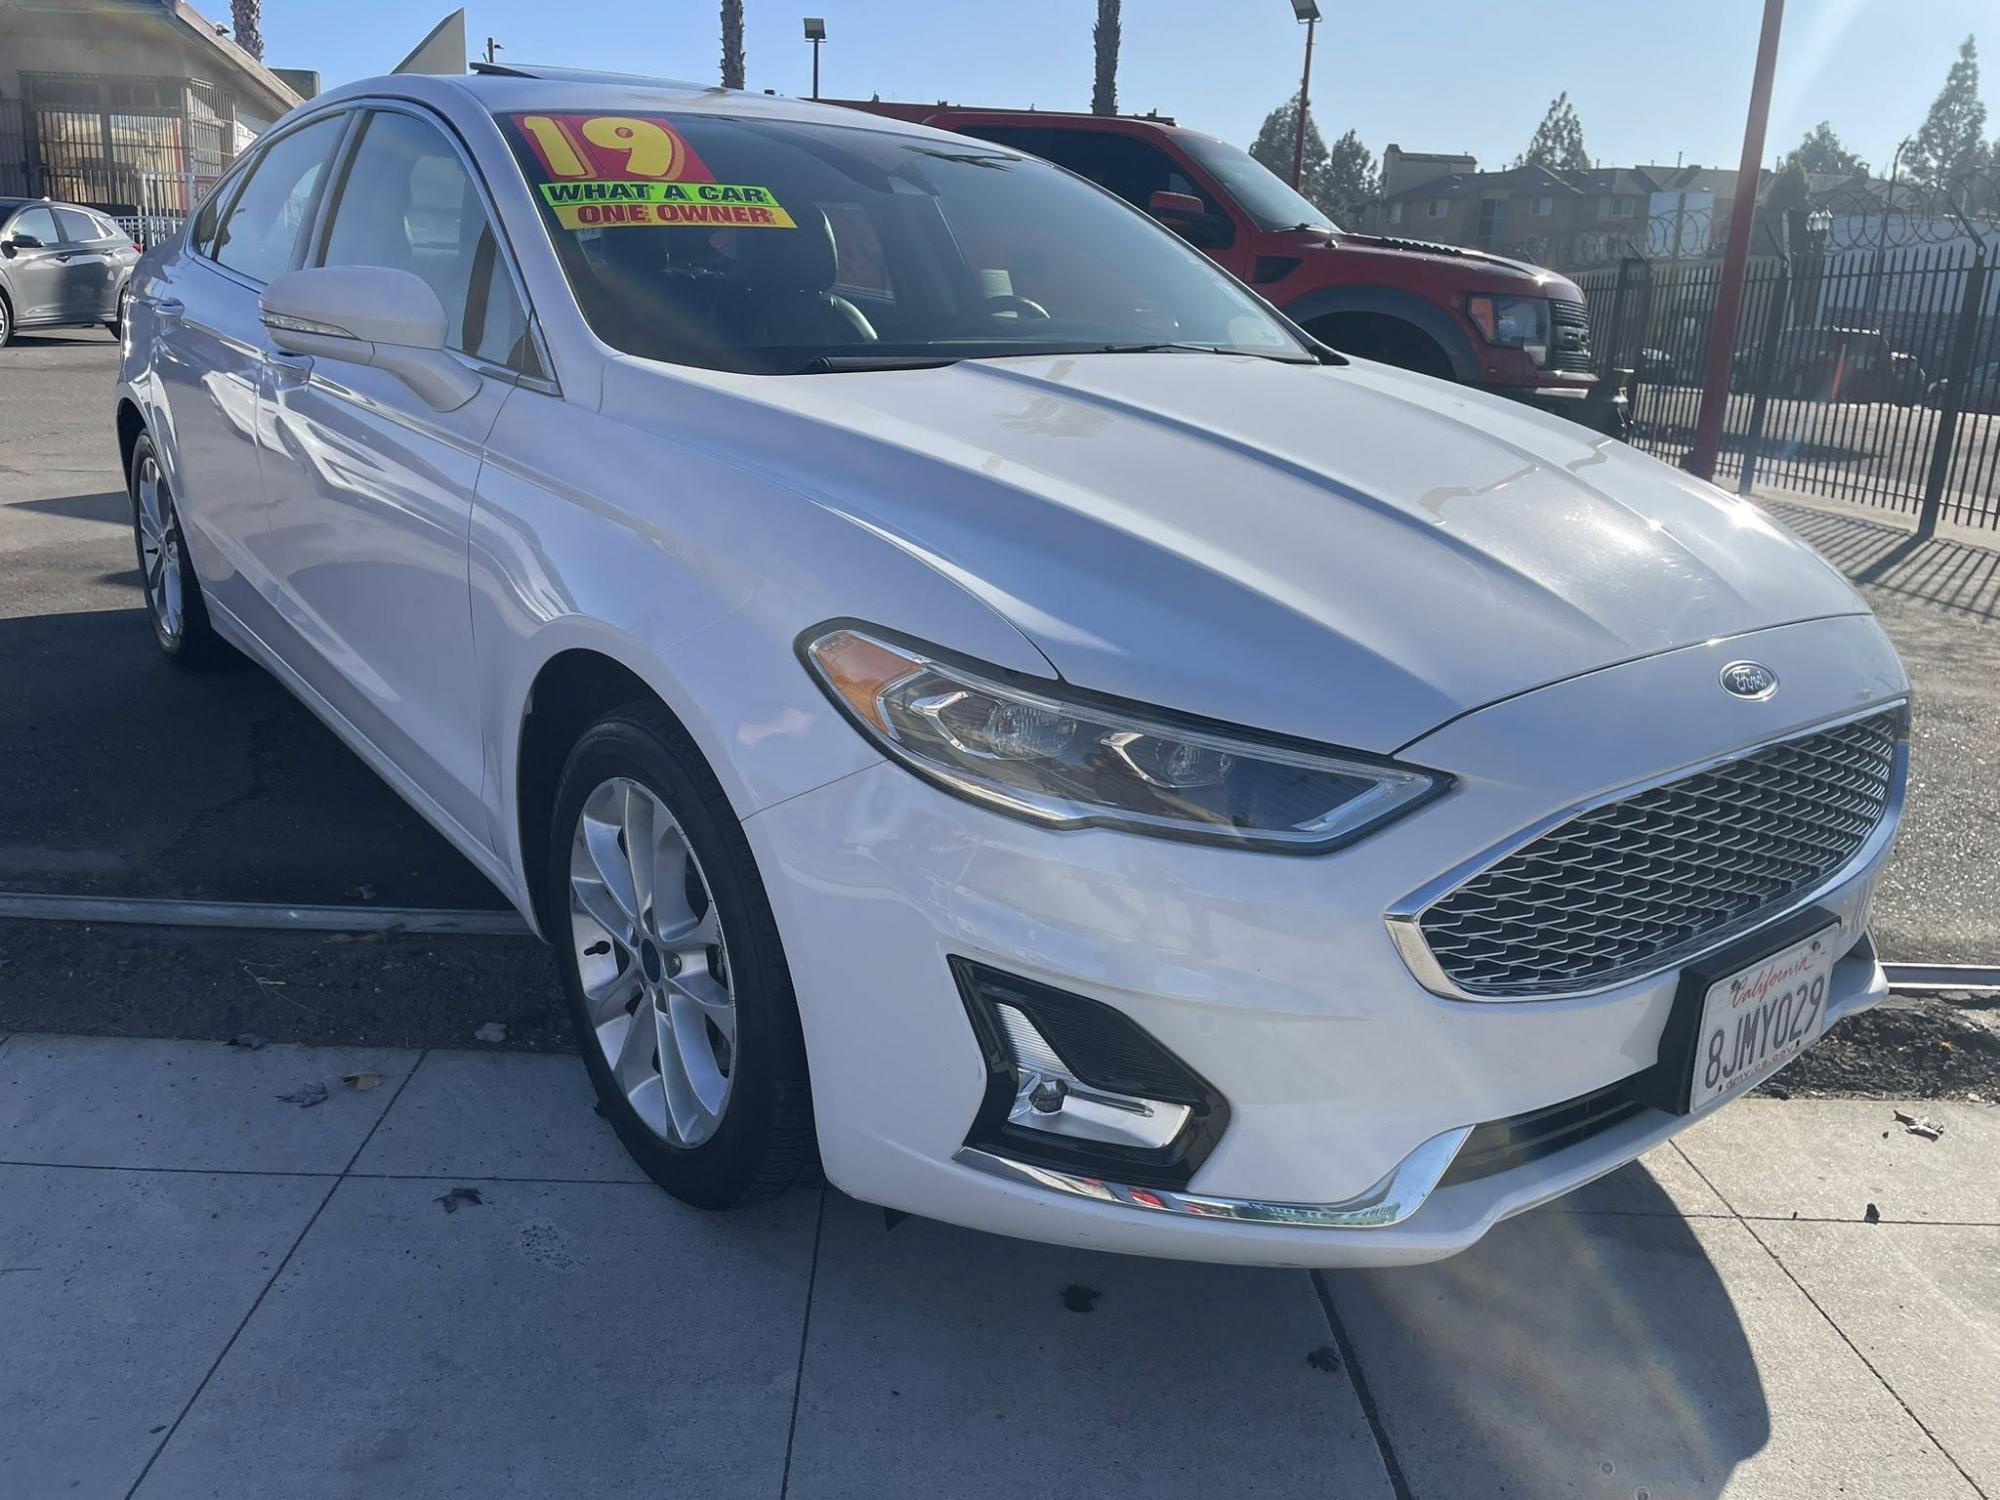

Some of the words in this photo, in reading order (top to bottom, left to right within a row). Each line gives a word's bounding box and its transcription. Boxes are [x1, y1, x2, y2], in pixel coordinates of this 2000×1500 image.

[523, 116, 680, 178] 19
[547, 183, 650, 203] WHAT
[664, 184, 689, 201] A
[698, 185, 769, 203] CAR
[577, 204, 649, 224] ONE
[656, 204, 773, 224] OWNER
[1731, 957, 1813, 1008] California
[1704, 975, 1825, 1089] 8JMY029
